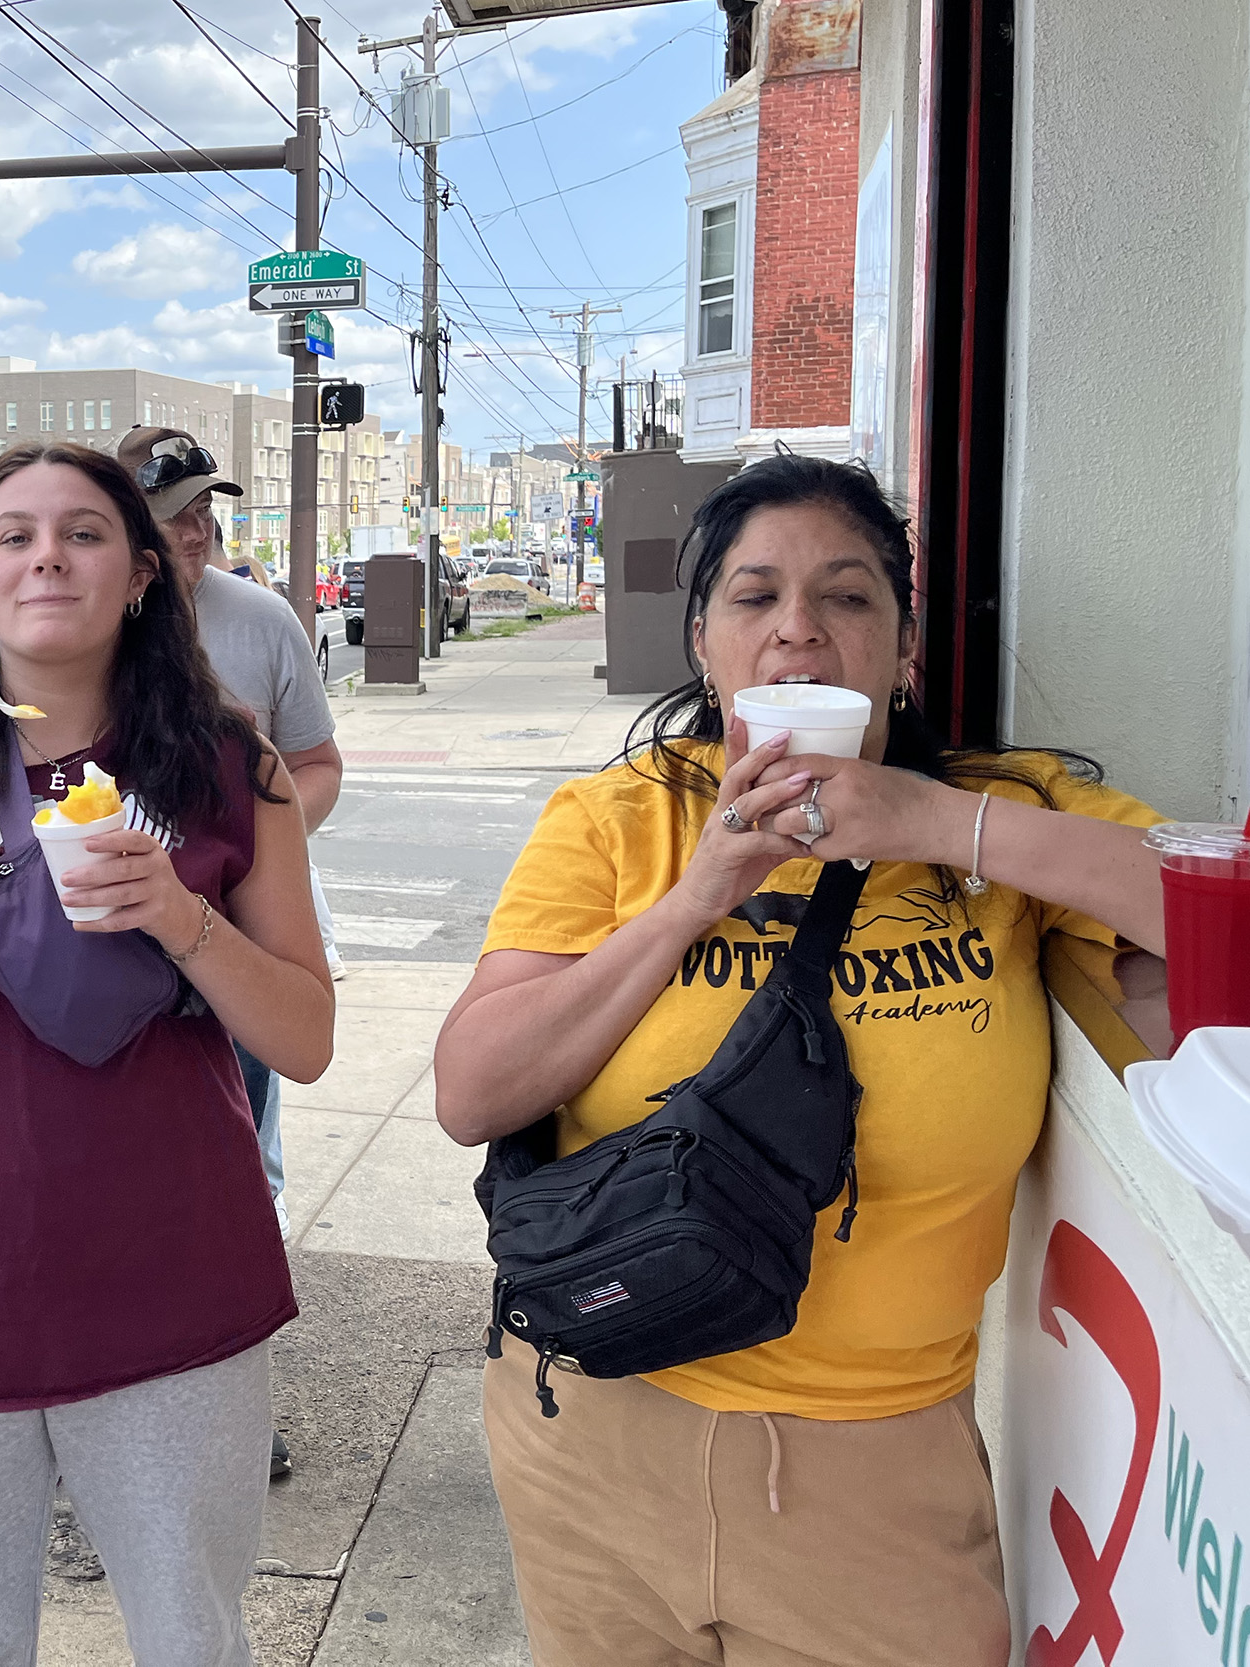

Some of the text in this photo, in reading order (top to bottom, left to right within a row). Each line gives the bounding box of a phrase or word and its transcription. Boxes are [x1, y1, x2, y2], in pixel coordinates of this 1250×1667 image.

[301, 251, 308, 260] N
[251, 260, 359, 280] Emerald St
[282, 287, 342, 302] ONE WAY
[49, 773, 67, 790] E
[667, 926, 994, 998] VOTT OXING
[844, 993, 993, 1034] Academy
